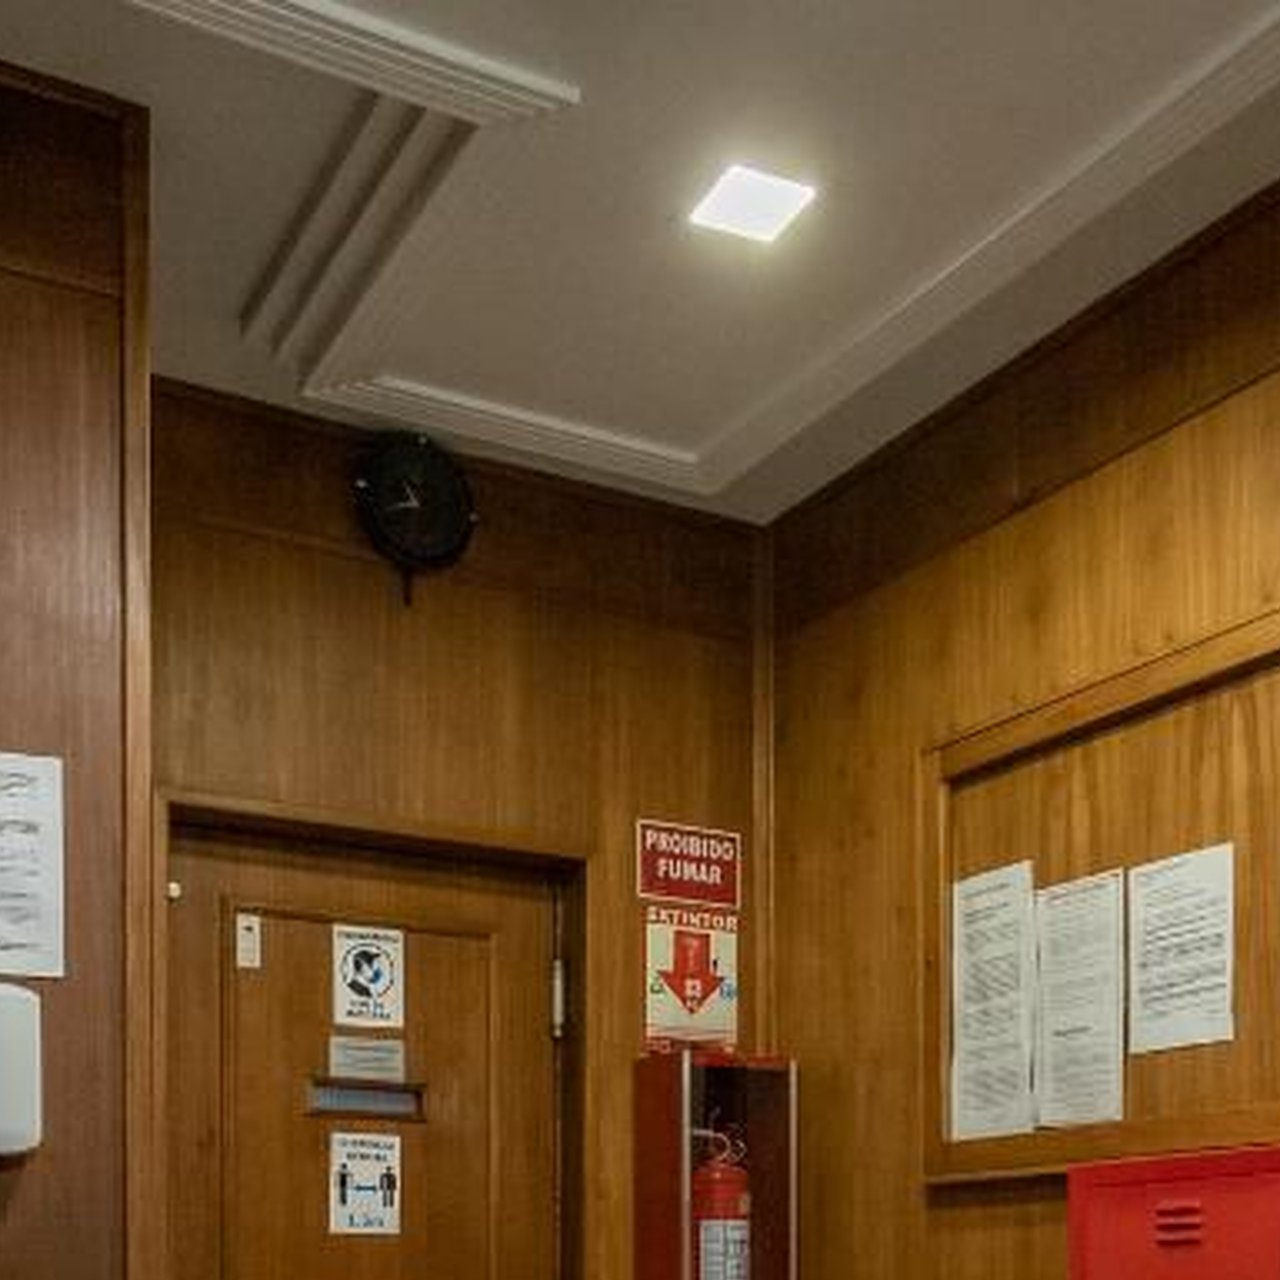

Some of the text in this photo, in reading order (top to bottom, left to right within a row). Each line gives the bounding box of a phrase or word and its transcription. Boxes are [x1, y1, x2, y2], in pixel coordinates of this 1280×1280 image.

[645, 830, 734, 861] PROIBIDO
[658, 858, 722, 885] FUMAR
[647, 906, 738, 931] EXTINTOR
